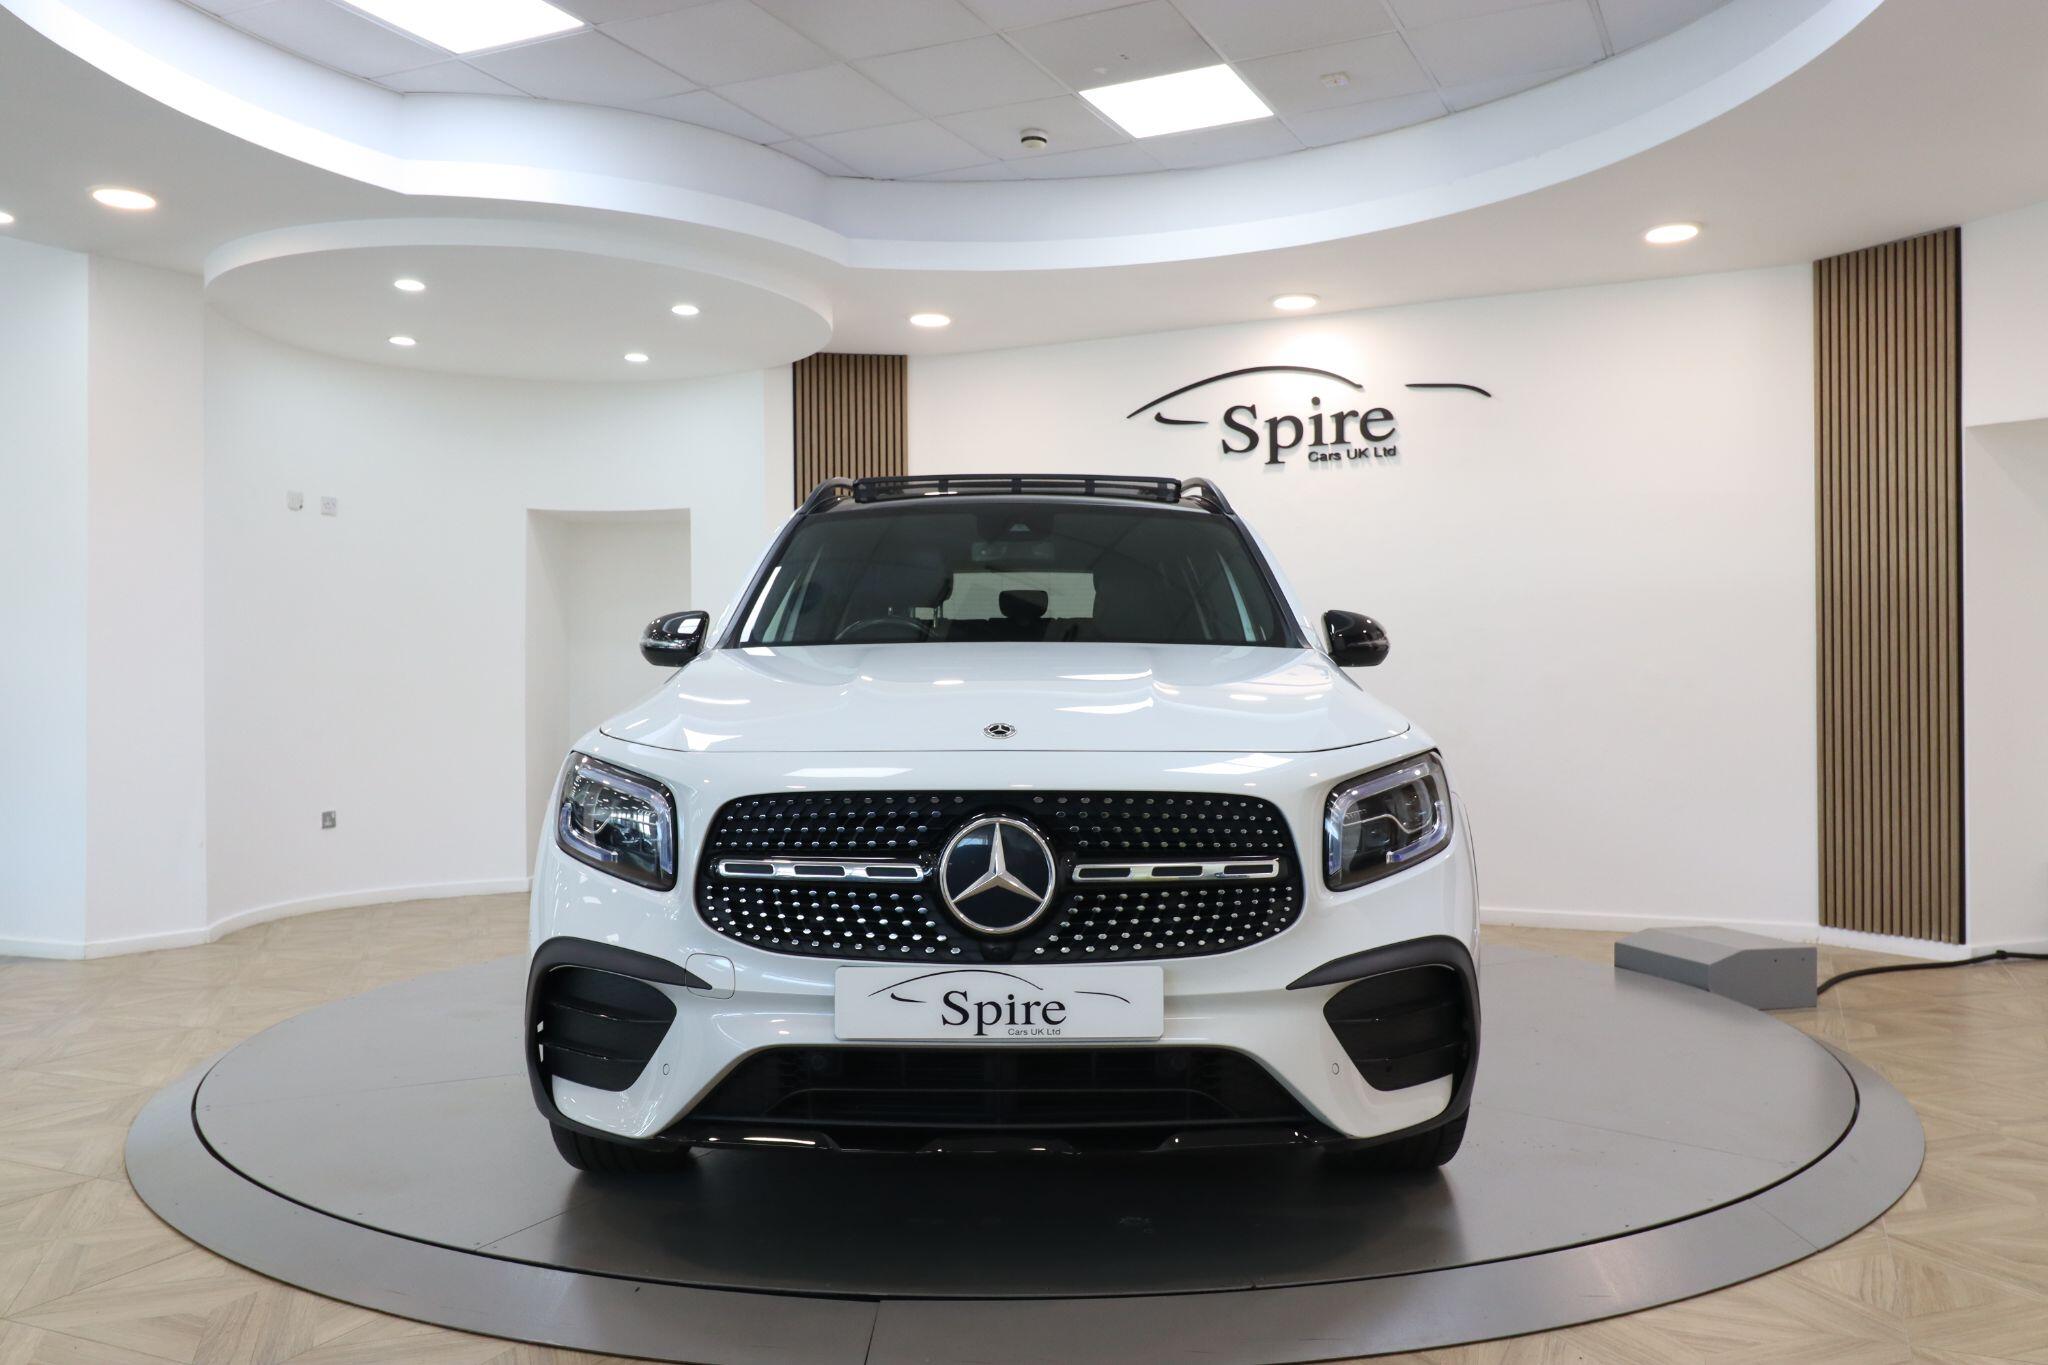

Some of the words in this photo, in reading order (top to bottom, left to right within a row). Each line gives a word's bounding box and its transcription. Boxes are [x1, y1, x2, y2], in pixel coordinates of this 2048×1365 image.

[1222, 397, 1396, 465] Spire
[1308, 451, 1342, 463] Cars
[1347, 448, 1369, 460] UK
[1374, 445, 1397, 458] Ltd
[942, 990, 1067, 1036] Spire
[1007, 1028, 1028, 1036] Cars
[1031, 1028, 1045, 1036] UK
[1047, 1028, 1061, 1036] Ltd
